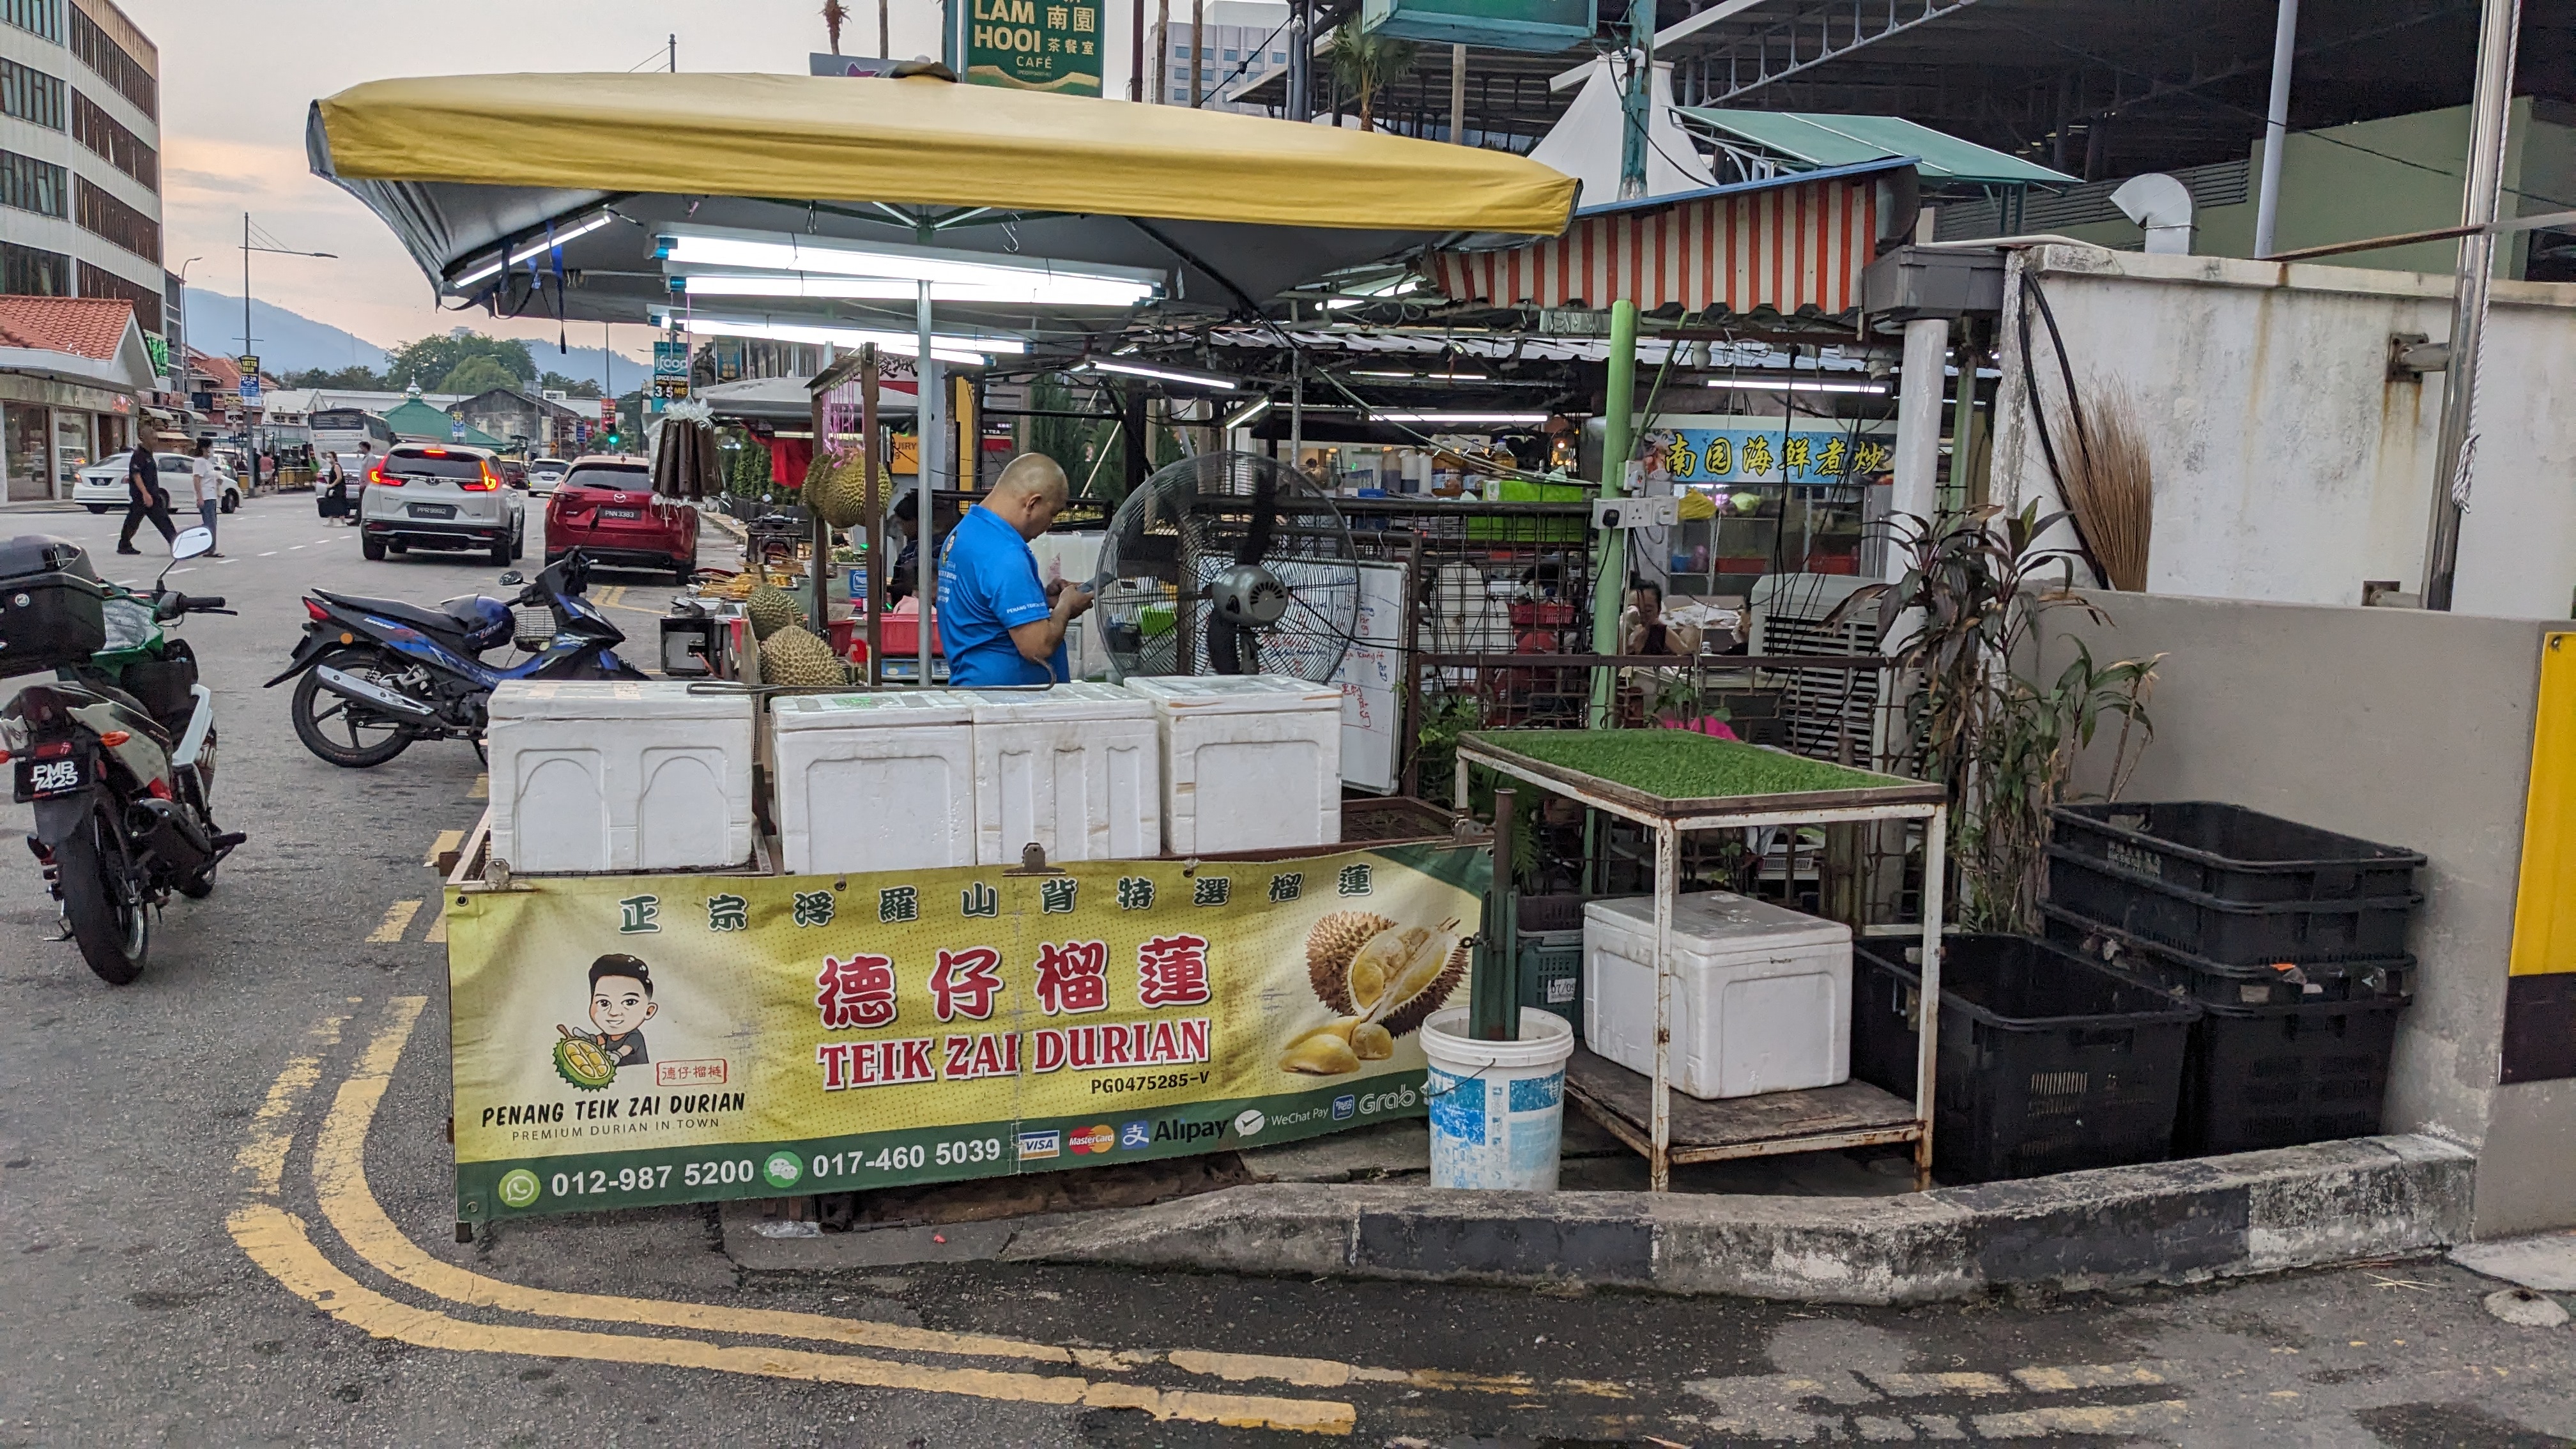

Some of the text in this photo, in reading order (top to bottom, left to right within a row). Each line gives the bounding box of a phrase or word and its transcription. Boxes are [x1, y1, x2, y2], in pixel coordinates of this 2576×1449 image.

[974, 0, 1035, 24] LAM
[1046, 5, 1094, 33] 南園
[974, 24, 1041, 53] HOOI
[1048, 38, 1094, 55] 茶餐室
[1016, 56, 1052, 69] CAFÉ
[674, 387, 688, 395] ME
[31, 772, 78, 792] 7425
[33, 760, 74, 779] PMB
[618, 862, 1374, 935] 正宗浮羅山背特選榴蓮
[815, 933, 1211, 1029] 德仔榴蓮
[816, 1018, 1211, 1091] TEIK ZAI DURIAN
[1090, 1071, 1210, 1094] PG0475285-V
[482, 1092, 746, 1128] PENANG TEIK ZAI DURIAN
[1359, 1084, 1416, 1114] Grab
[1271, 1112, 1310, 1126] WeChat
[1313, 1107, 1329, 1119] Pay
[512, 1117, 719, 1142] PREMIUM DURIAN IN TOWN
[1069, 1133, 1114, 1146] MasterCard
[1154, 1119, 1229, 1144] Alipay
[1025, 1139, 1054, 1151] VISA
[813, 1139, 1000, 1177] 017-460 5039
[551, 1160, 754, 1197] 012-987 5200
